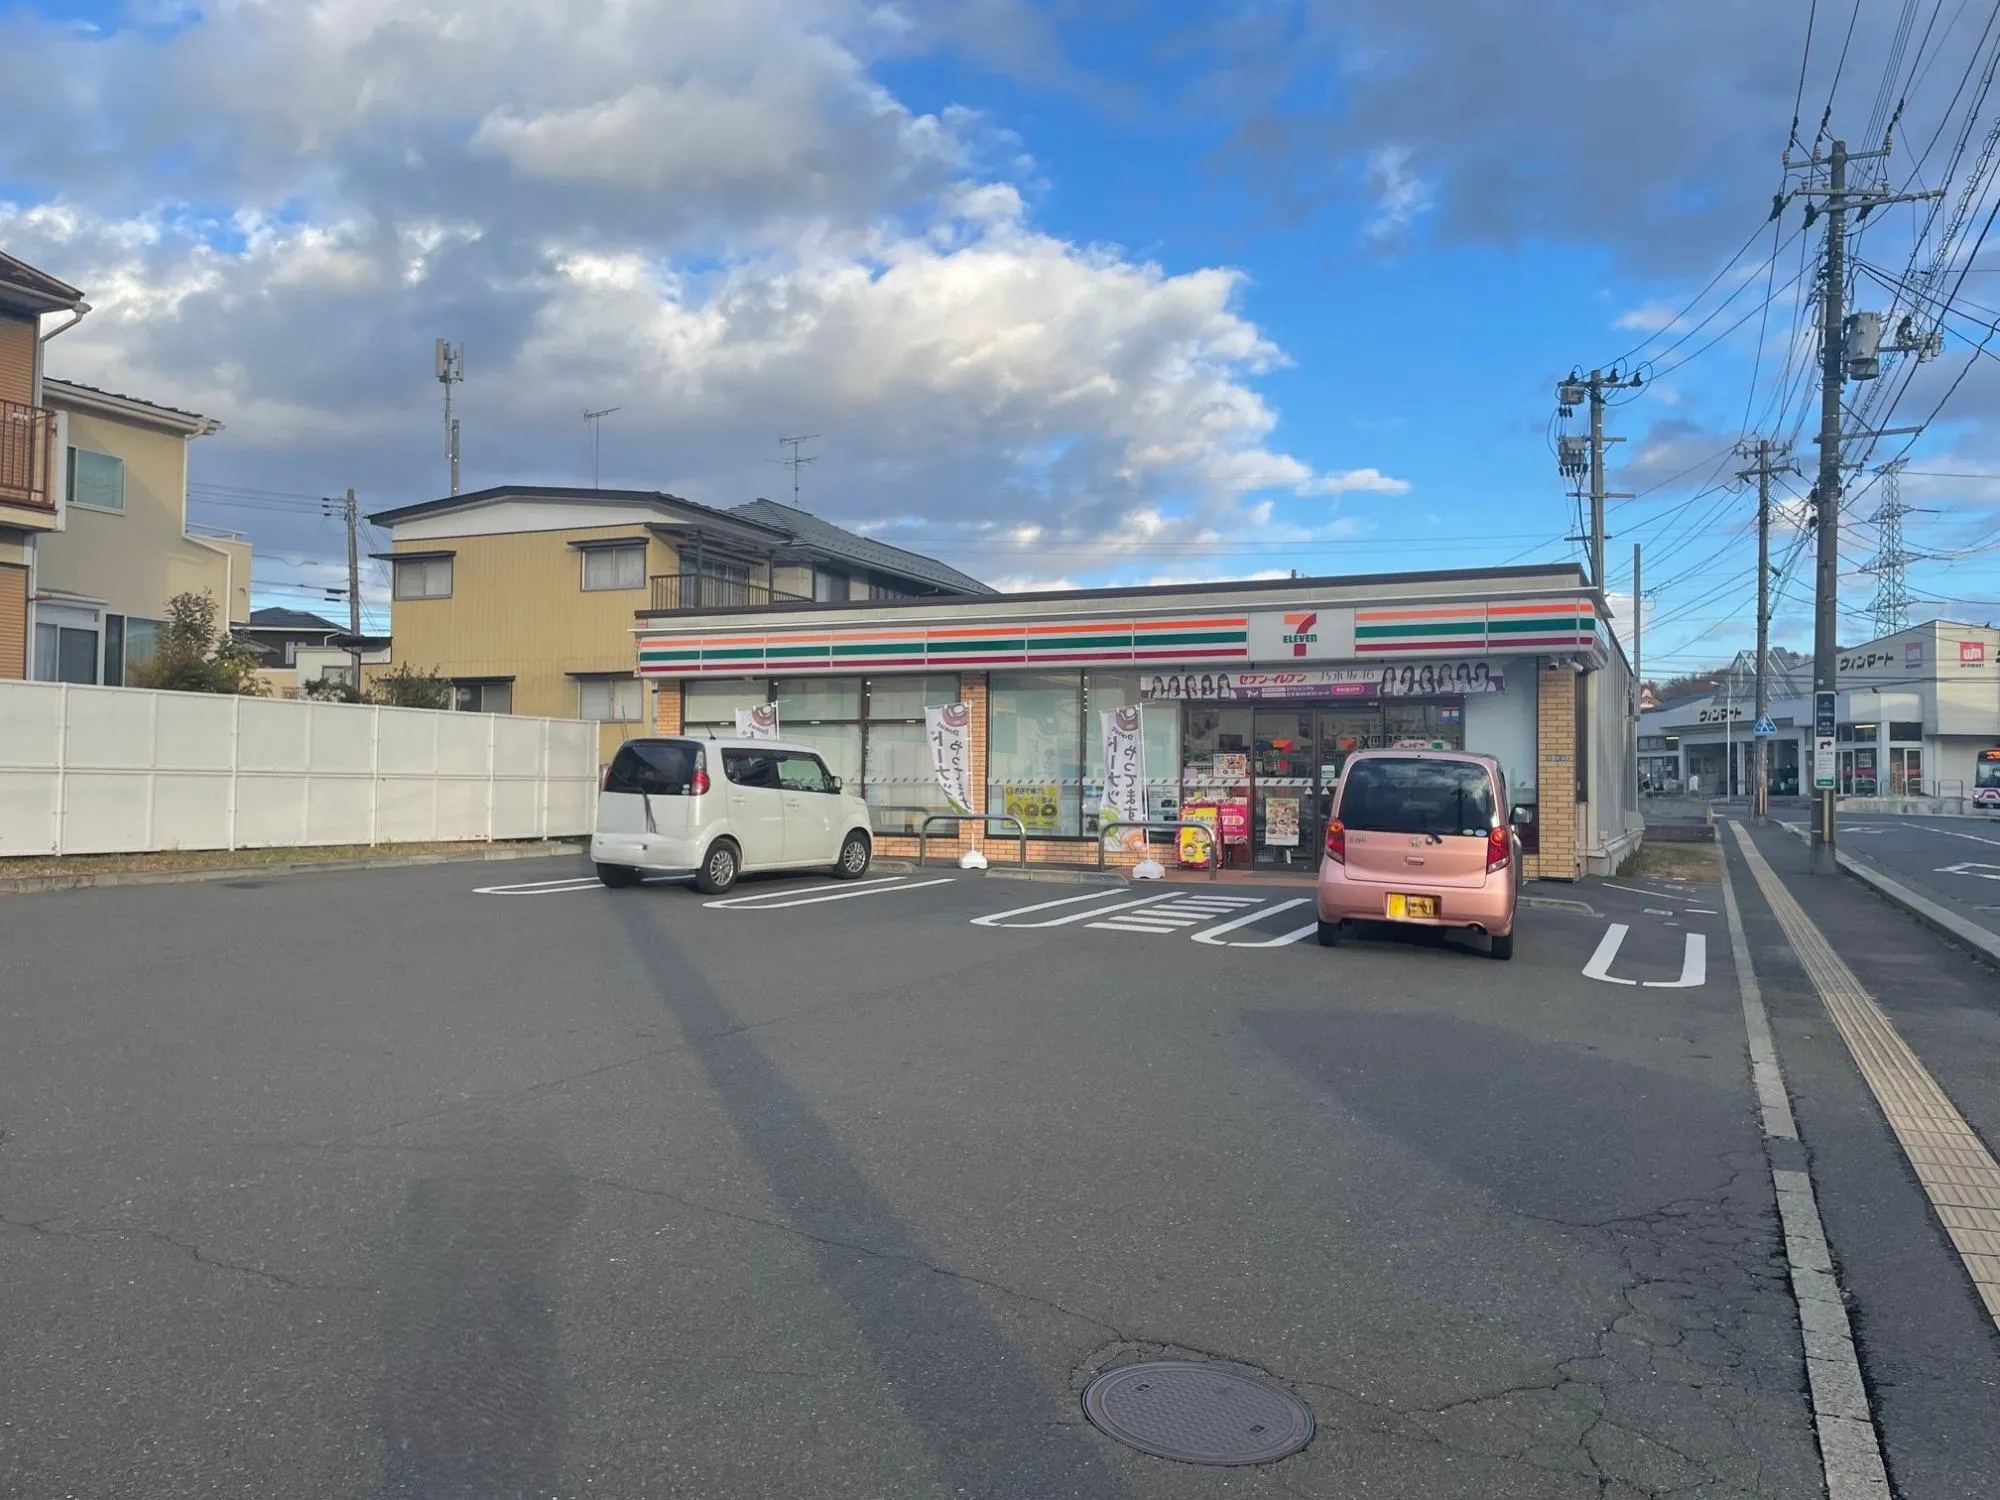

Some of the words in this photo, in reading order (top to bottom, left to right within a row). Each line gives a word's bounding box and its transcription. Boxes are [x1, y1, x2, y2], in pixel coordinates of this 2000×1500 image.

[1839, 652, 1895, 672] ウィンマート
[1699, 707, 1742, 722] ウィンマート
